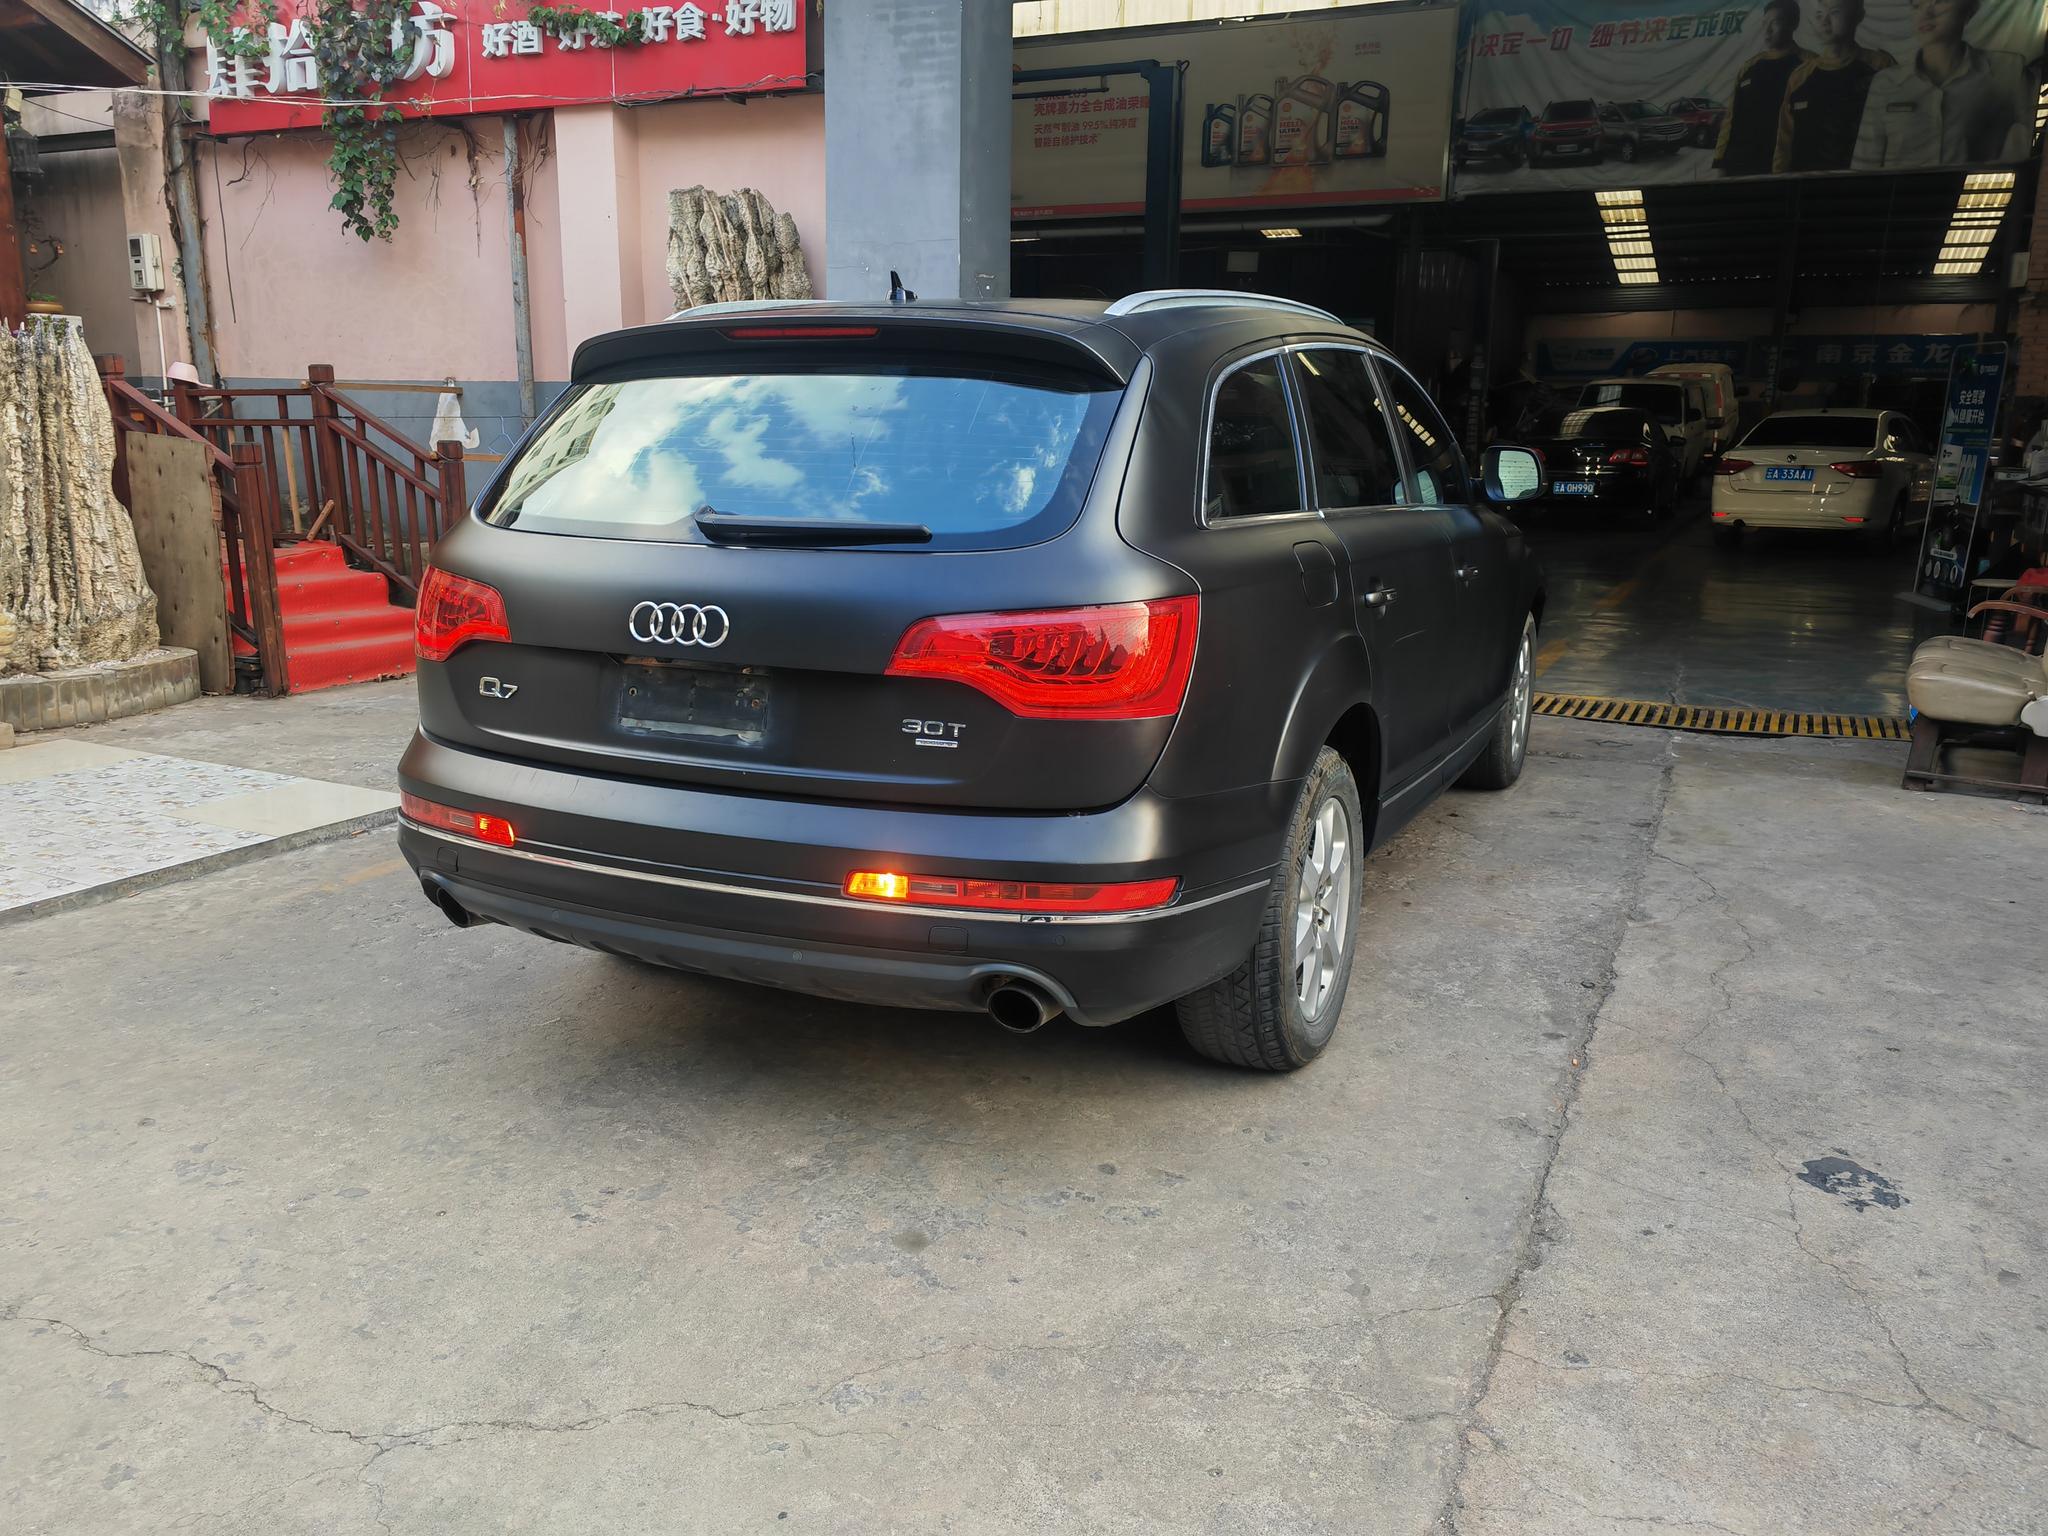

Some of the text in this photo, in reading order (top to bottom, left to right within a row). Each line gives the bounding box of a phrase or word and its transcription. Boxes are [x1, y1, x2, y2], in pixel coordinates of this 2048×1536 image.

[205, 3, 459, 99] 肆拾坊
[1471, 11, 1748, 57] 决定一切 细节决定成败
[479, 676, 518, 699] Q7
[902, 718, 967, 738] 30T
